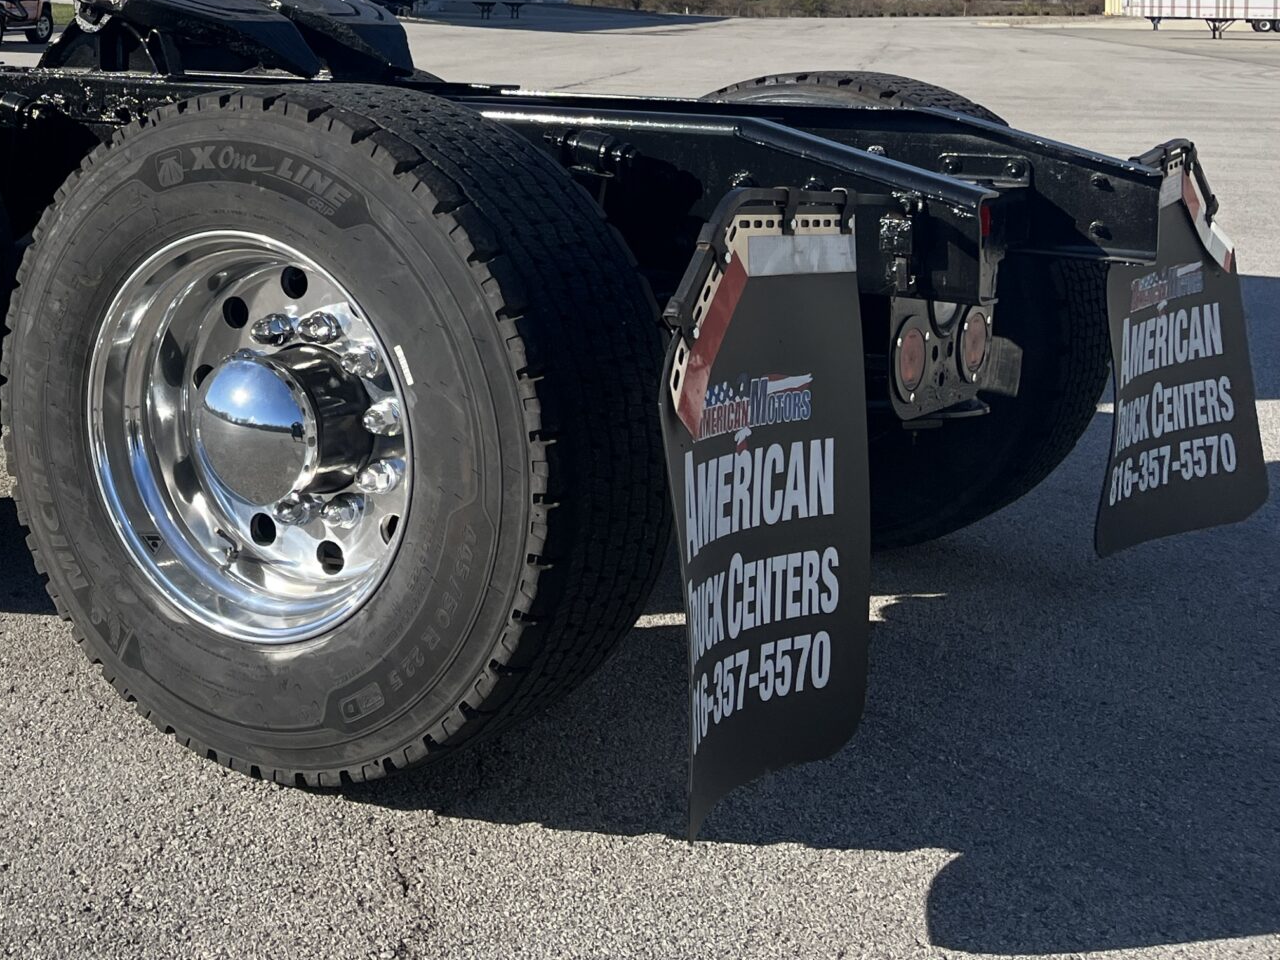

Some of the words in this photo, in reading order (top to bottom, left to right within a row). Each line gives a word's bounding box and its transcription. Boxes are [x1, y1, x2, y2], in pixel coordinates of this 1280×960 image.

[190, 145, 216, 171] X
[218, 145, 275, 172] One
[276, 156, 353, 209] LINE
[306, 196, 336, 217] GRIP
[1120, 302, 1223, 390] AMERICAN
[696, 398, 750, 442] MERICAN
[1114, 393, 1150, 458] TRUCK
[1151, 375, 1235, 438] CENTERS
[684, 438, 835, 565] AMERICAN
[1109, 432, 1237, 507] 816-357-5570
[727, 546, 839, 640] CENTERS
